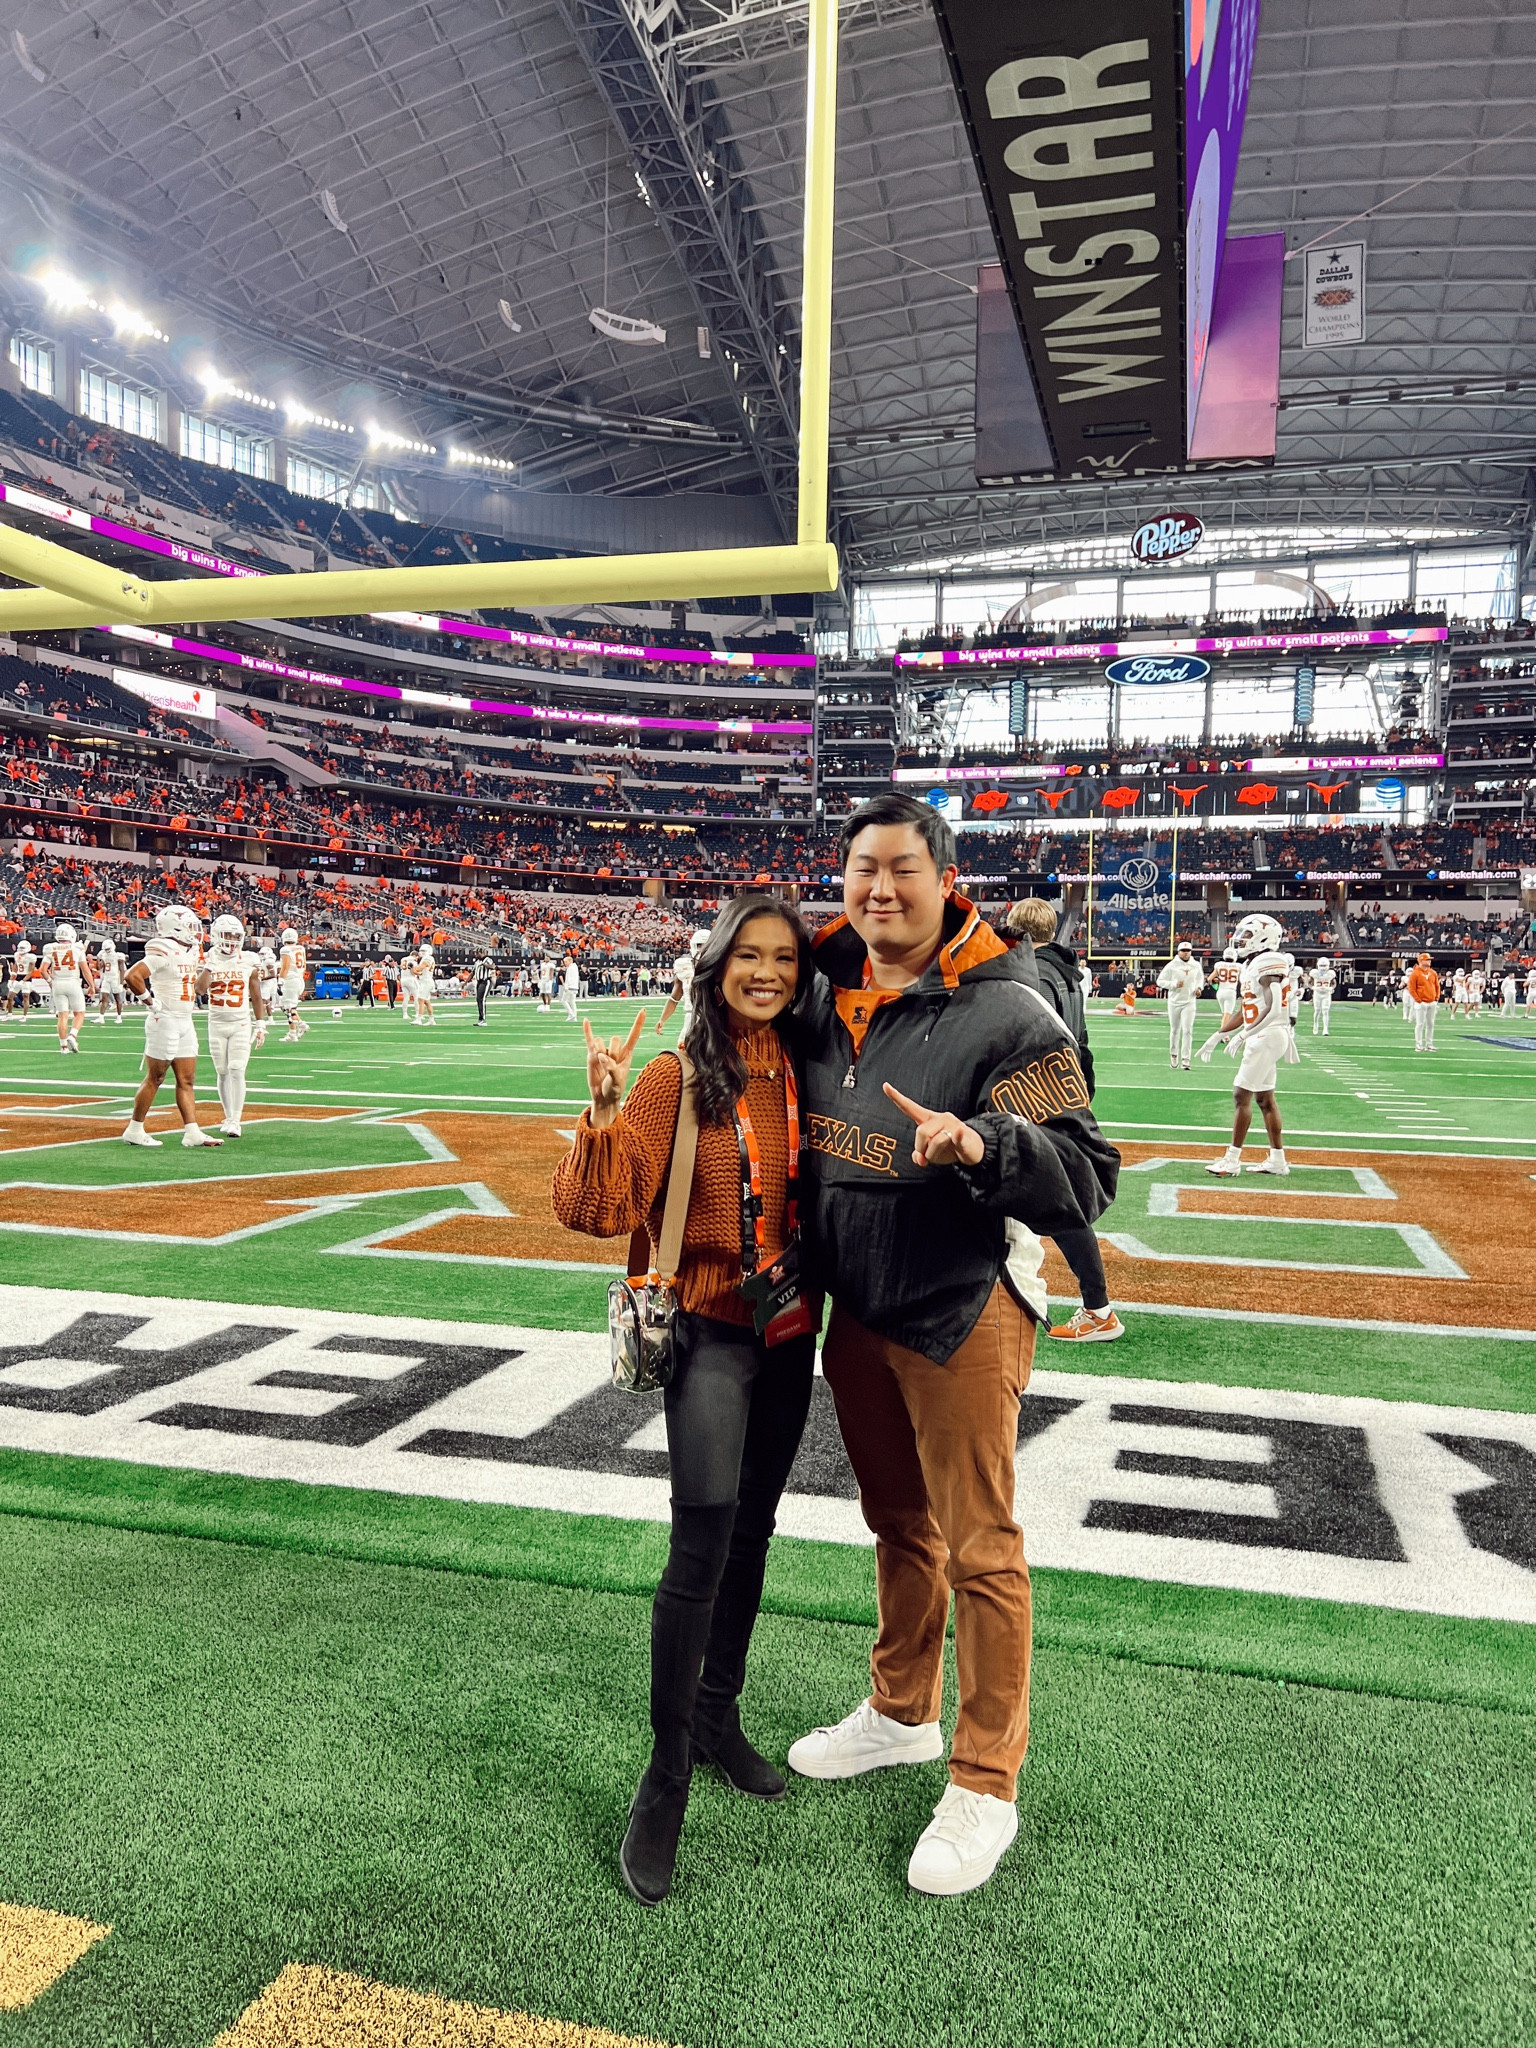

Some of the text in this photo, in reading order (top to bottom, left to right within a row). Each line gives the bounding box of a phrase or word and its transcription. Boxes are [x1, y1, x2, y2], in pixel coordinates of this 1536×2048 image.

[985, 38, 1166, 404] WINSTAR
[1316, 273, 1353, 284] COWBOYS
[1320, 266, 1349, 275] DALLAS
[1318, 314, 1350, 323] WORLD
[1309, 322, 1360, 333] CHAMPIONS
[1159, 518, 1186, 539] Dr
[171, 544, 261, 578] big wins for smal
[511, 631, 645, 657] big wins for small patients
[1215, 632, 1369, 649] big wins for small patients
[959, 645, 1100, 662] big wins for small patients
[241, 655, 343, 686] big wins for small patients
[1125, 658, 1190, 682] Ford
[533, 707, 639, 726] big wins for small patients
[1312, 755, 1438, 769] big wins for small patients
[950, 769, 963, 779] big
[965, 768, 985, 777] wins
[987, 768, 998, 776] for
[1000, 767, 1024, 776] small
[1025, 766, 1060, 777] patients
[955, 873, 1007, 884] ckchain.com
[1180, 872, 1251, 881] Blockchain.com
[1307, 871, 1381, 881] Blockchain.com
[1439, 869, 1517, 880] Blockchain.com
[1107, 892, 1169, 910] Allstate
[52, 950, 76, 971] 14
[210, 971, 243, 980] TEXAS
[1219, 968, 1238, 983] 96
[210, 980, 245, 1007] 29
[989, 1047, 1091, 1124] ONG
[806, 1112, 897, 1171] EXAS
[777, 1286, 796, 1305] VIP
